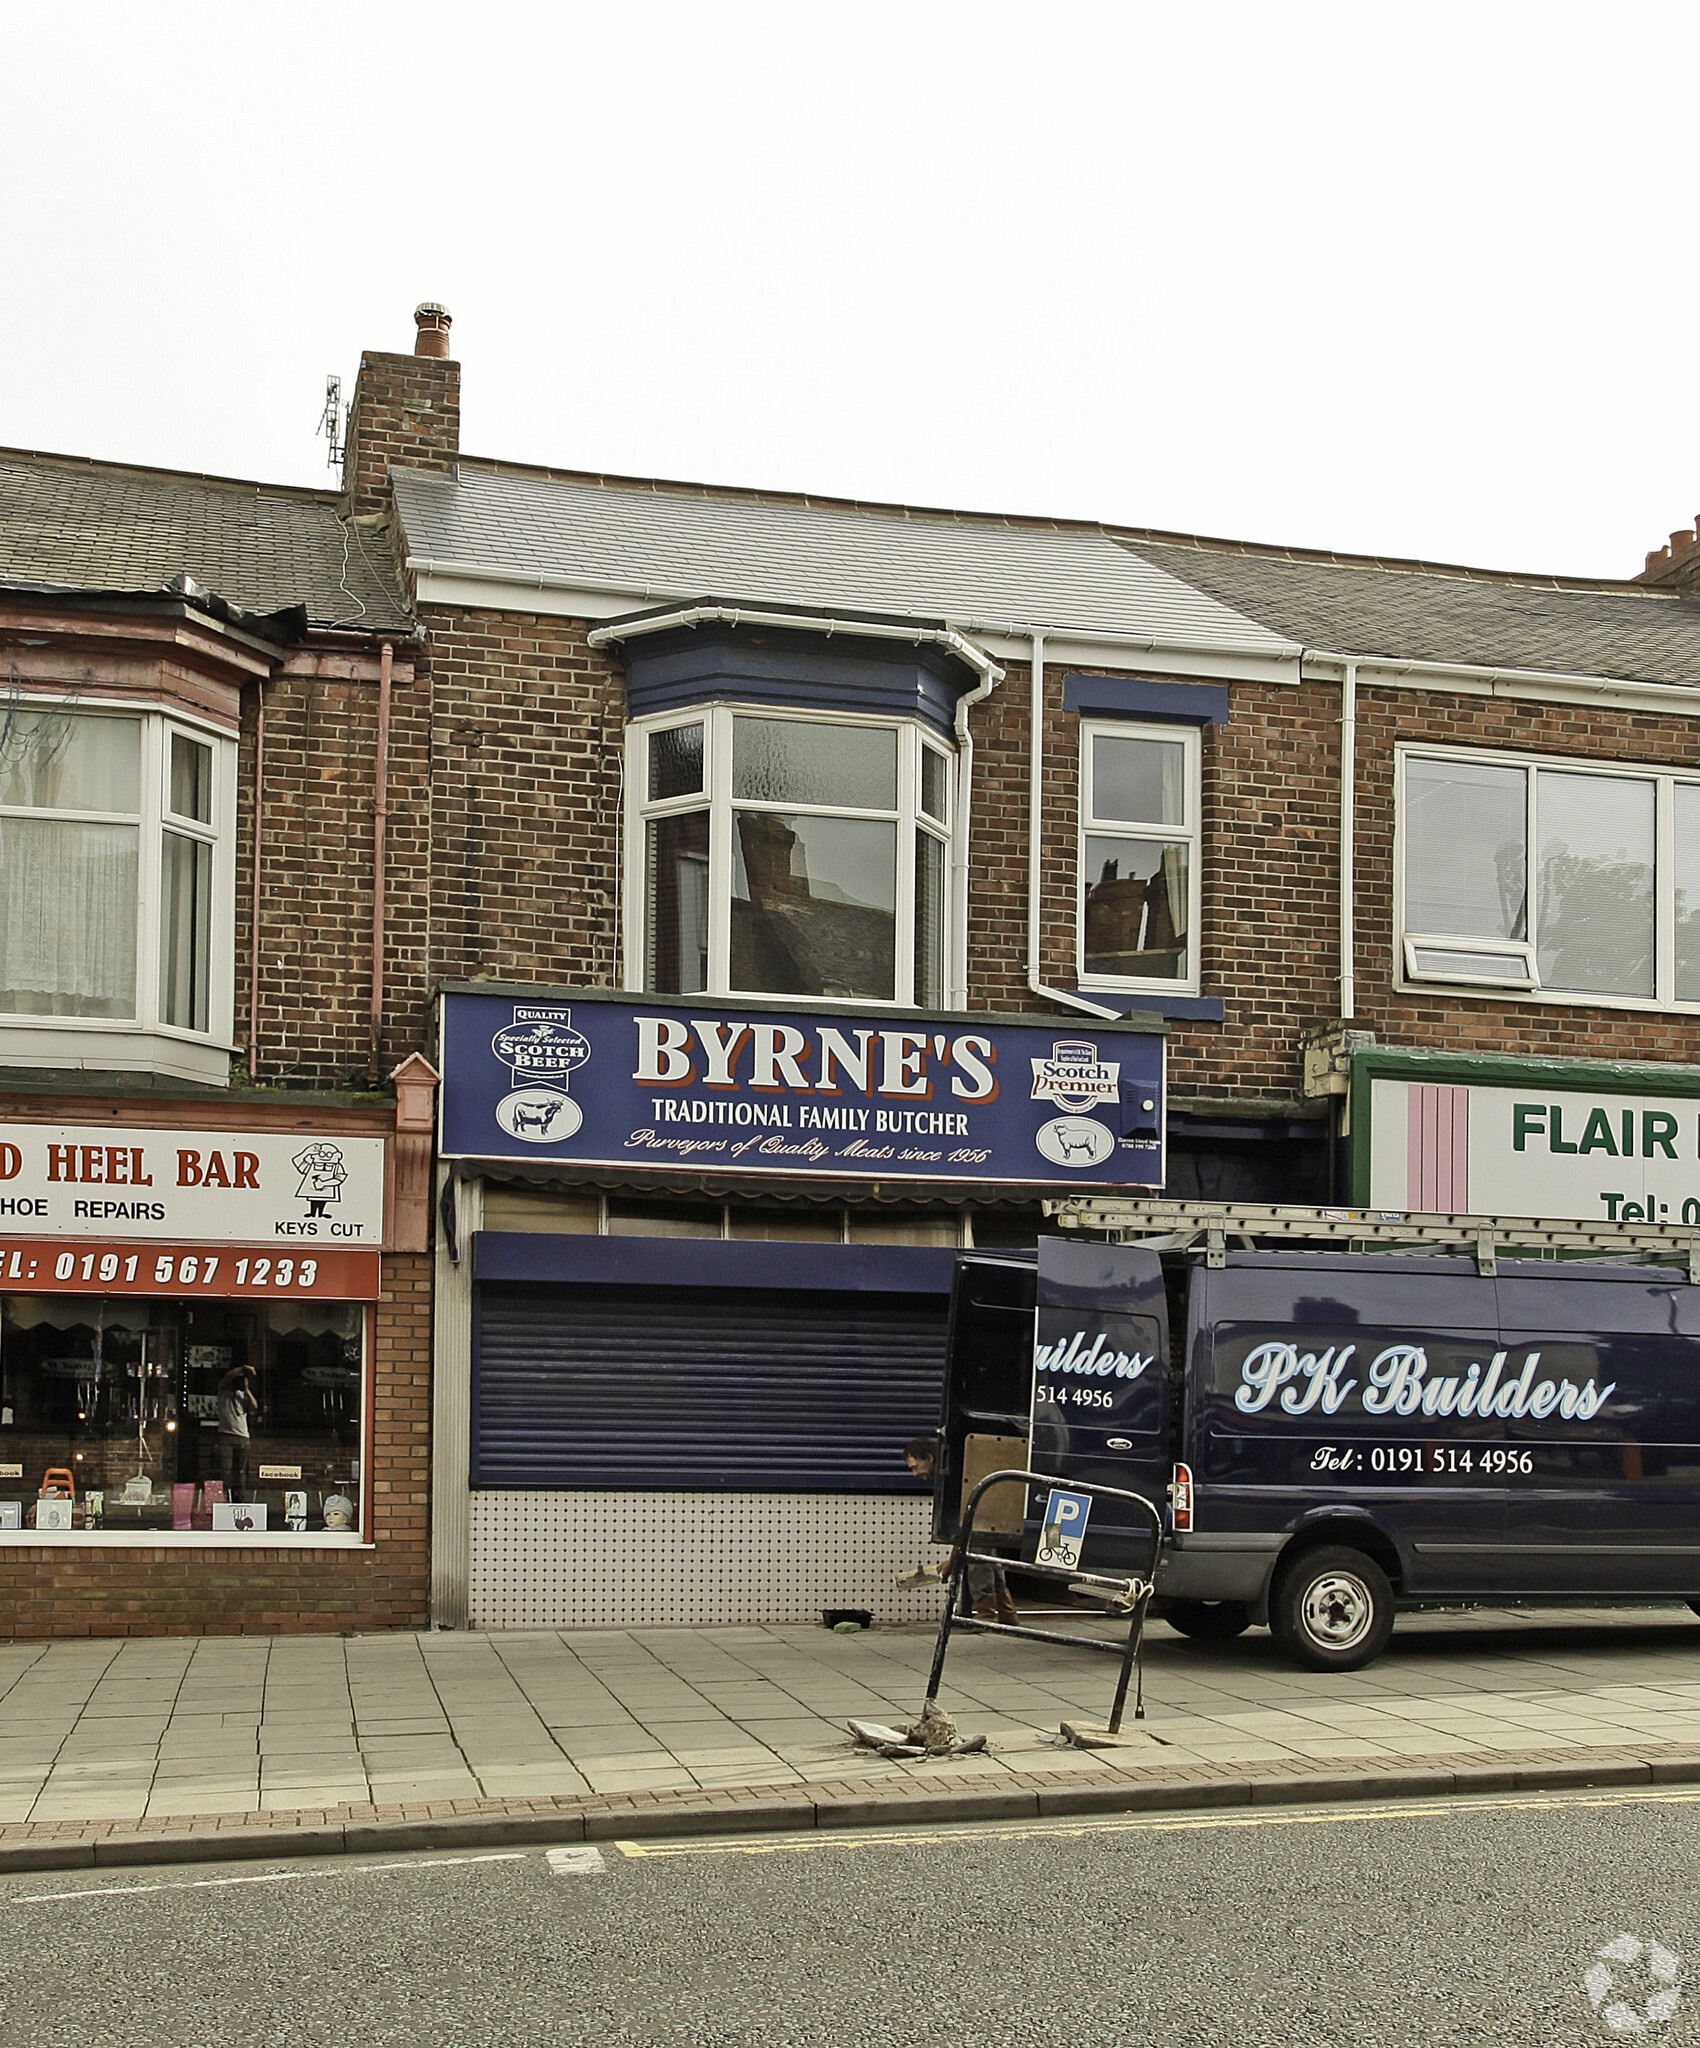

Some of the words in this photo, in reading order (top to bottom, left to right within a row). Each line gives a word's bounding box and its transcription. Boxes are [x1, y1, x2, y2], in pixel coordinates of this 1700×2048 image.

[517, 1009, 567, 1020] QUALITY
[498, 1033, 540, 1044] Specially
[542, 1036, 583, 1044] Selected
[499, 1042, 585, 1057] SCOTCH
[514, 1054, 571, 1068] BEEF
[632, 1016, 996, 1102] BYRNE'S
[1043, 1061, 1109, 1080] Scotch
[652, 1098, 793, 1128] TRADITIONAL
[799, 1106, 870, 1132] FAMILY
[876, 1109, 969, 1136] BUTCHER
[1513, 1103, 1679, 1160] FLAIR
[624, 1128, 728, 1156] Purveyors
[731, 1134, 763, 1158] of
[758, 1135, 830, 1162] Quality
[835, 1138, 896, 1160] Meats
[897, 1146, 943, 1162] since
[947, 1148, 992, 1164] 1956
[47, 1144, 153, 1187] HEEL
[176, 1149, 261, 1189] BAR
[74, 1200, 166, 1220] REPAIRS
[1600, 1192, 1669, 1224] Tel:
[274, 1221, 318, 1236] KEYS
[331, 1222, 364, 1238] CUT
[54, 1251, 139, 1283] 0191
[154, 1255, 220, 1284] 567
[235, 1258, 319, 1287] 1233
[1234, 1341, 1358, 1415] PK
[1362, 1344, 1617, 1421] Builders
[1036, 1385, 1068, 1405] 514
[1071, 1388, 1114, 1408] 4956
[1310, 1445, 1363, 1472] Tel:
[1371, 1447, 1425, 1473] 0191
[1432, 1449, 1474, 1473] 514
[1479, 1450, 1534, 1474] 4956
[260, 1471, 300, 1479] facebook
[1055, 1497, 1080, 1525] P
